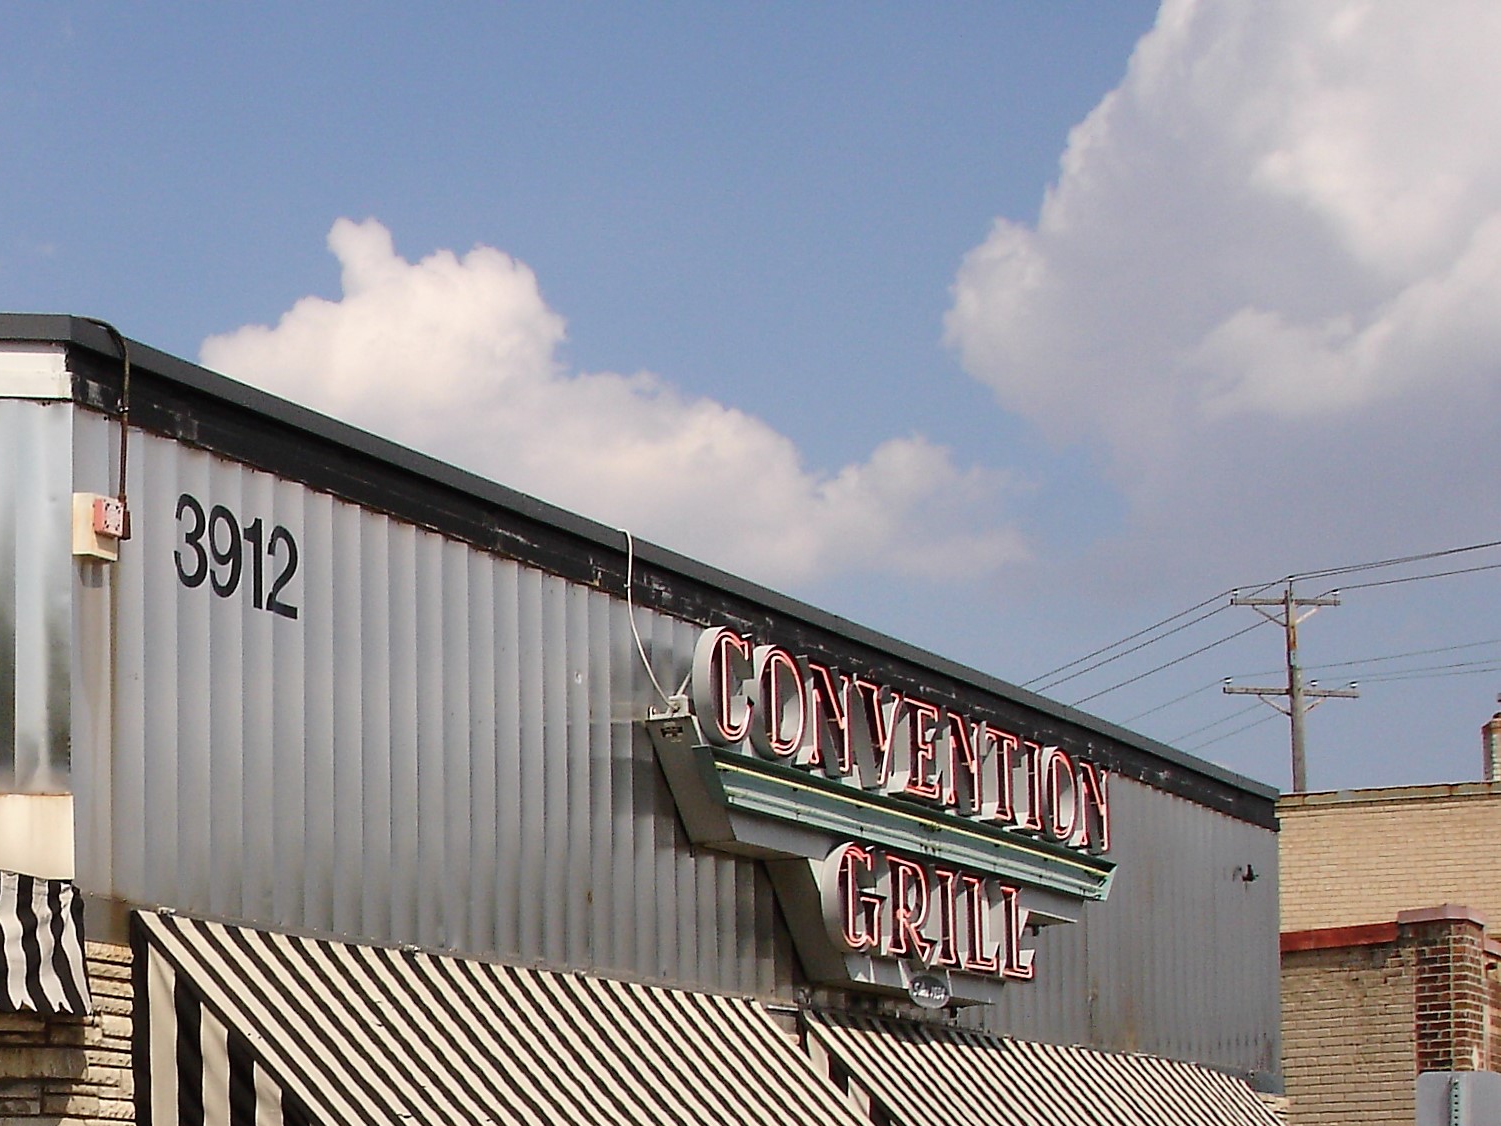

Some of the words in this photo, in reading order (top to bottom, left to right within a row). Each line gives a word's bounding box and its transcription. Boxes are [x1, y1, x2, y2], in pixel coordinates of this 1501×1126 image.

[174, 493, 298, 620] 3912
[693, 626, 1112, 854] CONVENTION
[820, 840, 1036, 981] GRILL
